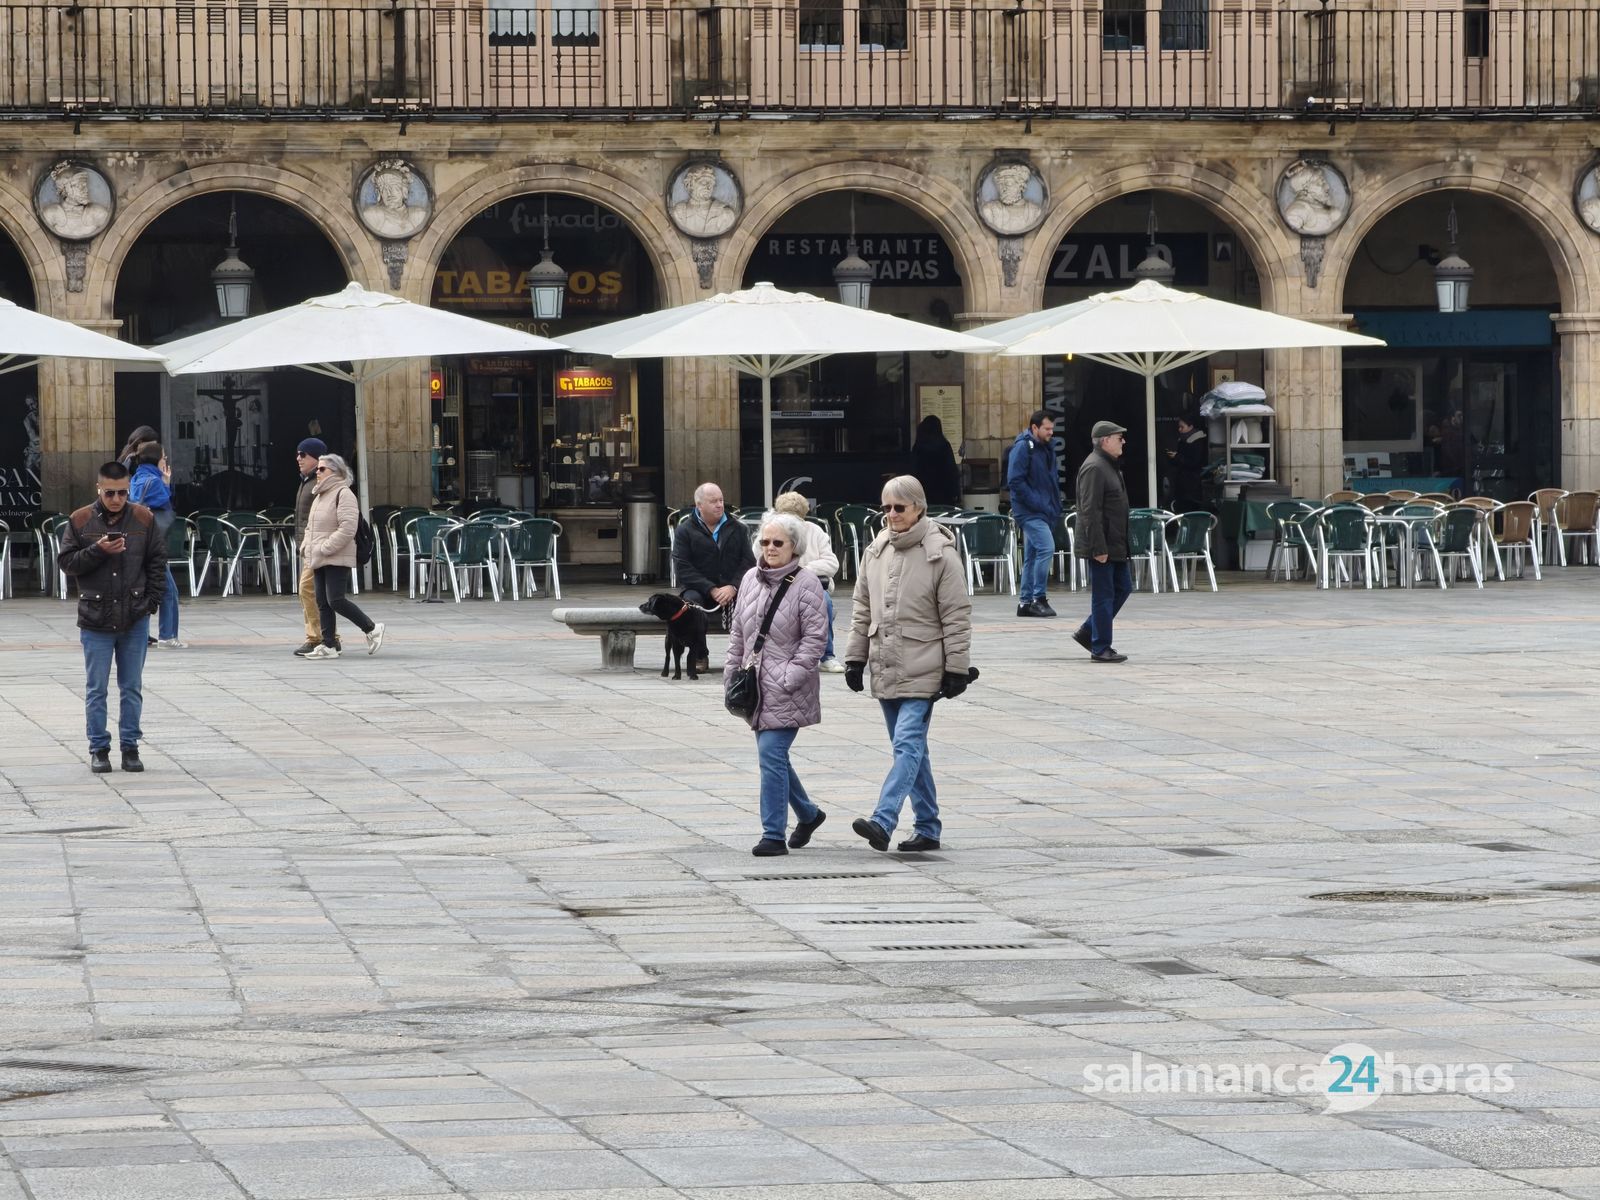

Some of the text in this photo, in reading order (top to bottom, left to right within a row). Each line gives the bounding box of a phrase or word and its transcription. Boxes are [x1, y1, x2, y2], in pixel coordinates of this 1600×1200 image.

[867, 259, 939, 280] TAPAS
[436, 271, 624, 295] TABAOS
[573, 377, 613, 387] TABACOS
